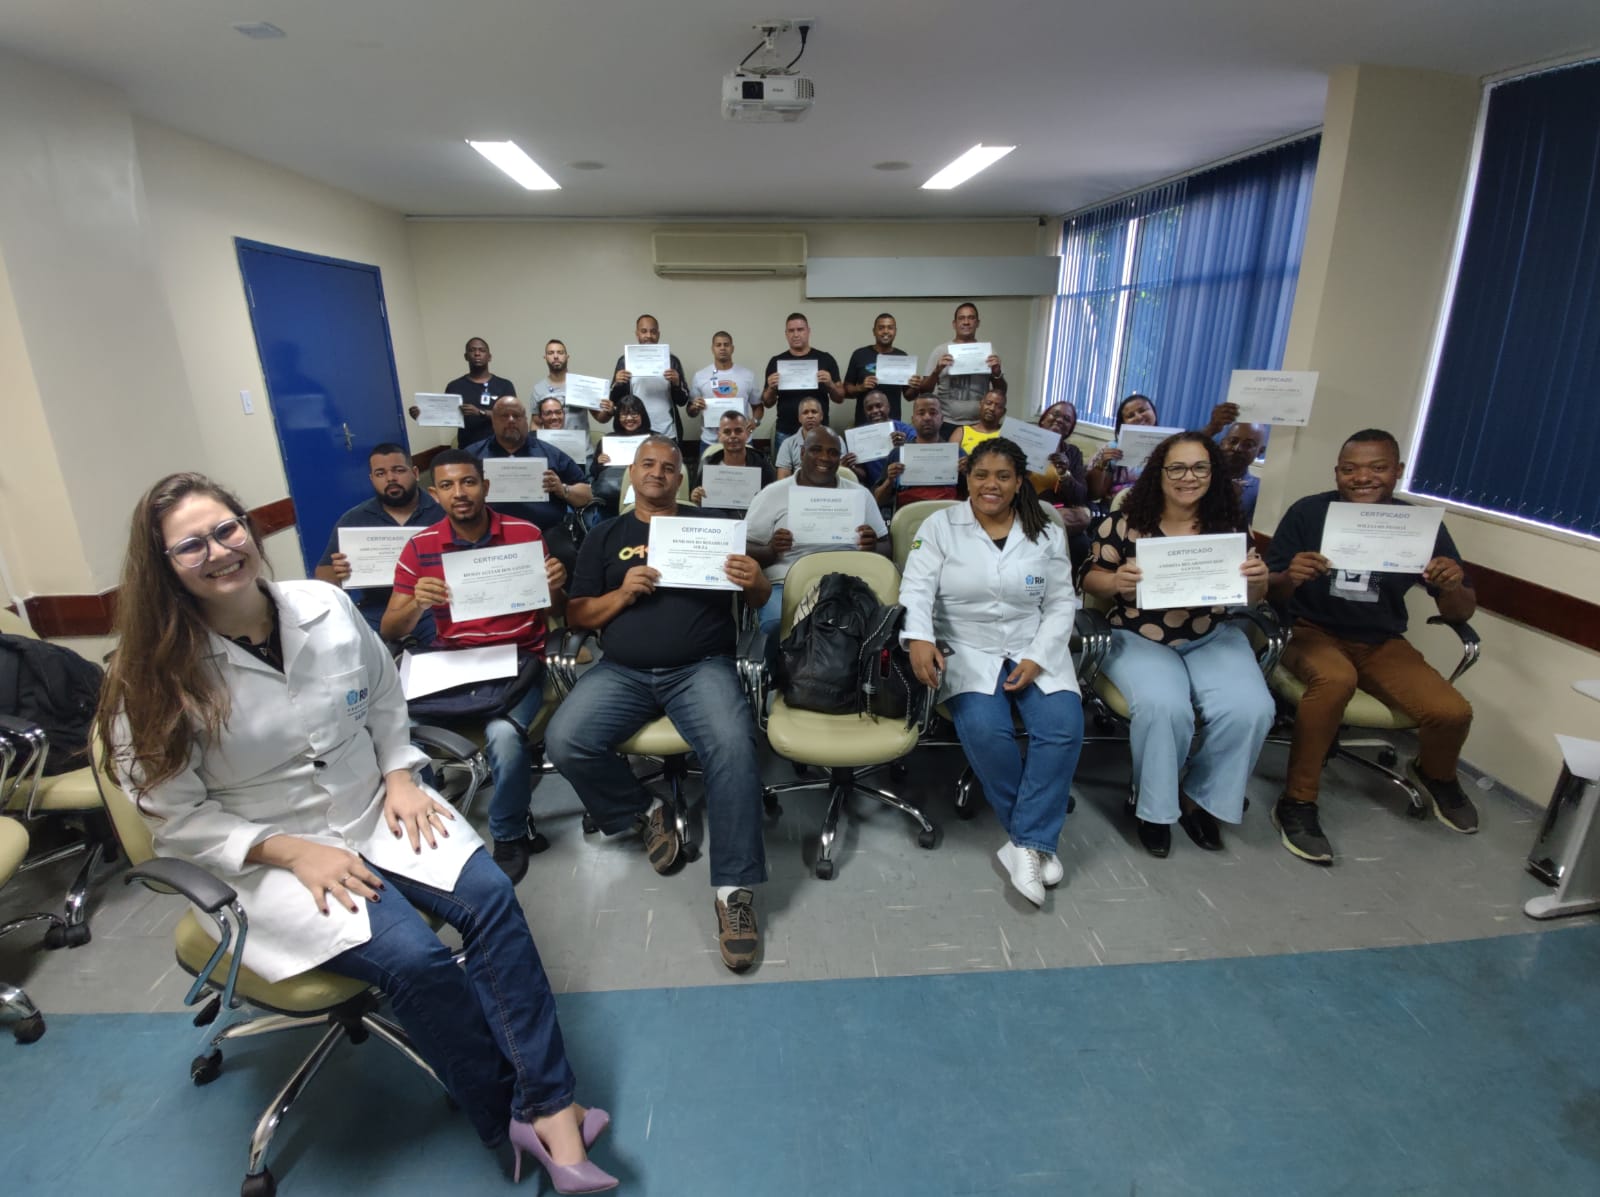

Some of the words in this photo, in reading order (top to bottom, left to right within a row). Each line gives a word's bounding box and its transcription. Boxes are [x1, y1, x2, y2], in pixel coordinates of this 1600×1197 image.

[1360, 511, 1410, 519] CERTIFICADO
[681, 526, 721, 534] CERTIFICADO
[1167, 547, 1213, 556] CERTIFICADO
[473, 552, 518, 565] CERTIFICADO
